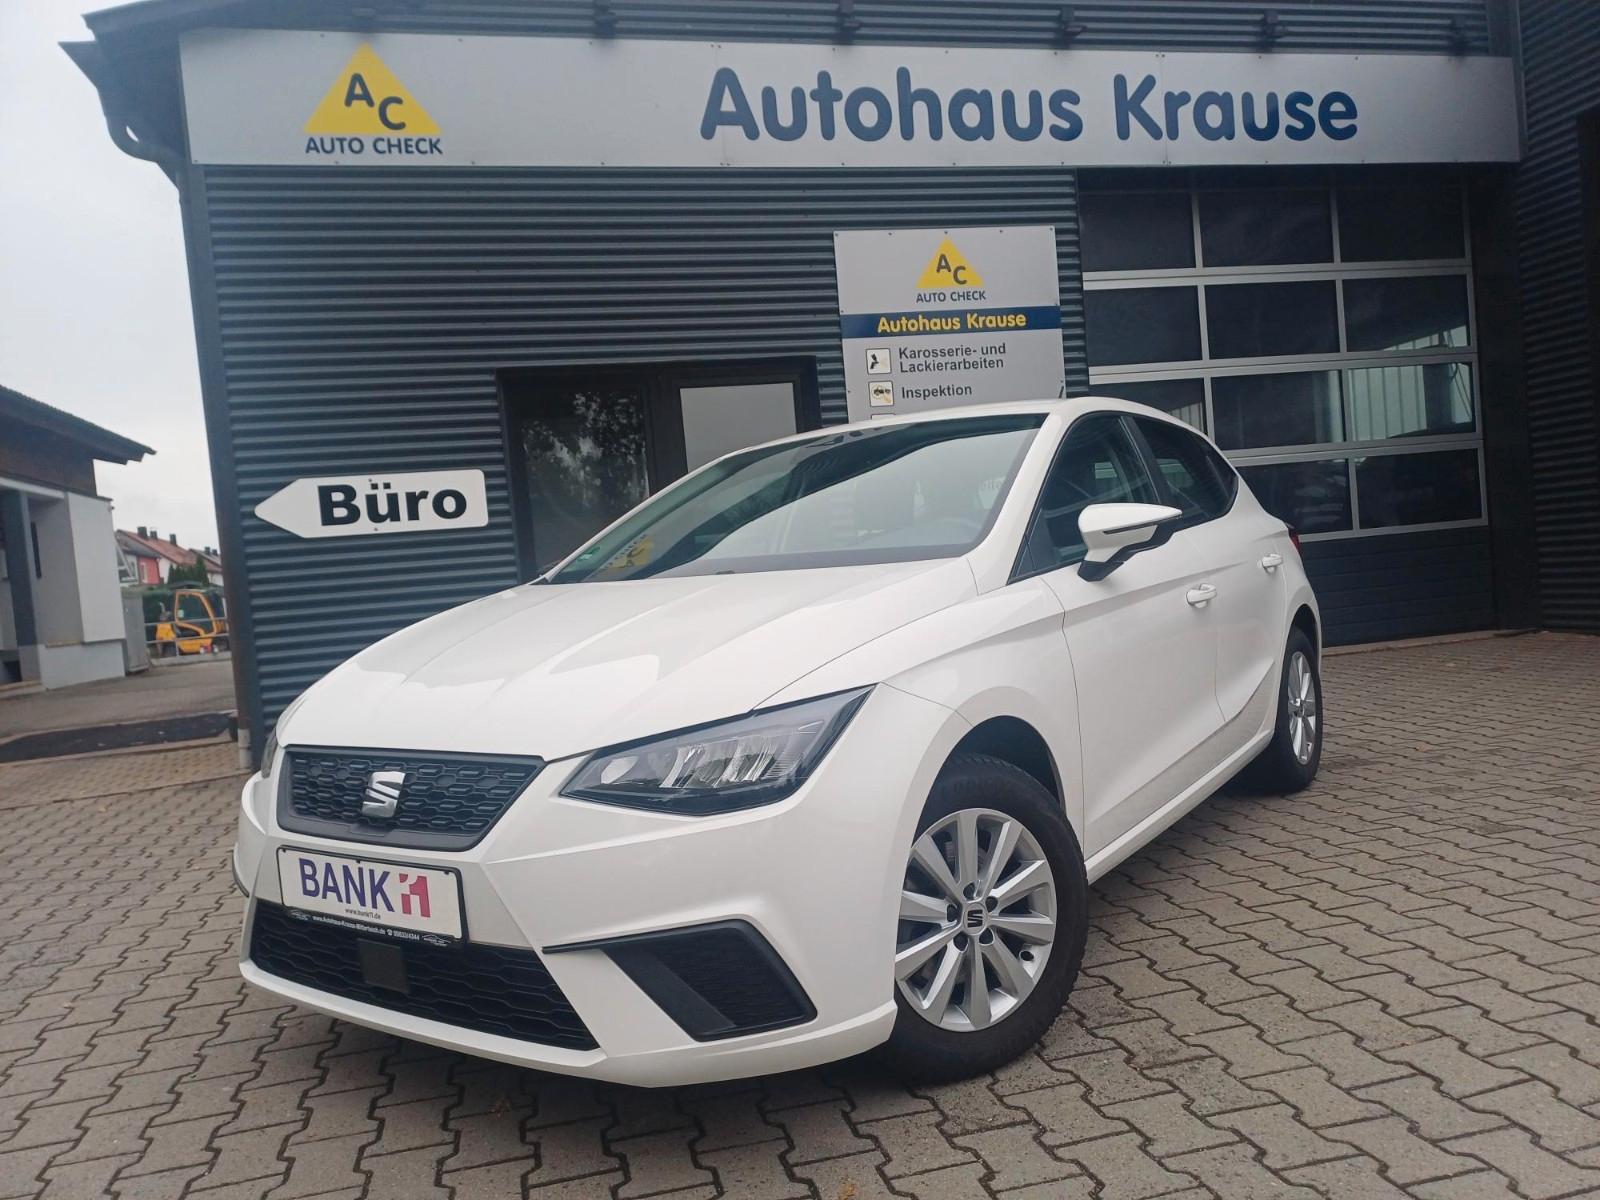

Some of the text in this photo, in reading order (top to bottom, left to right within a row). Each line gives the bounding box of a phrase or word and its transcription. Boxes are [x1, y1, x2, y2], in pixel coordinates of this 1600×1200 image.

[345, 73, 375, 107] A
[378, 96, 406, 130] C
[700, 67, 1358, 142] Autohaus Krause
[305, 137, 443, 154] AUTO CHECK
[936, 253, 951, 274] A
[953, 265, 967, 285] C
[916, 290, 986, 303] AUTO CHECK
[877, 313, 1026, 333] Autohaus Krause
[898, 343, 1006, 360] Karosserie- und
[900, 358, 1004, 373] Lackierarbeiten
[901, 384, 972, 400] Inspektion
[317, 482, 467, 526] Büro
